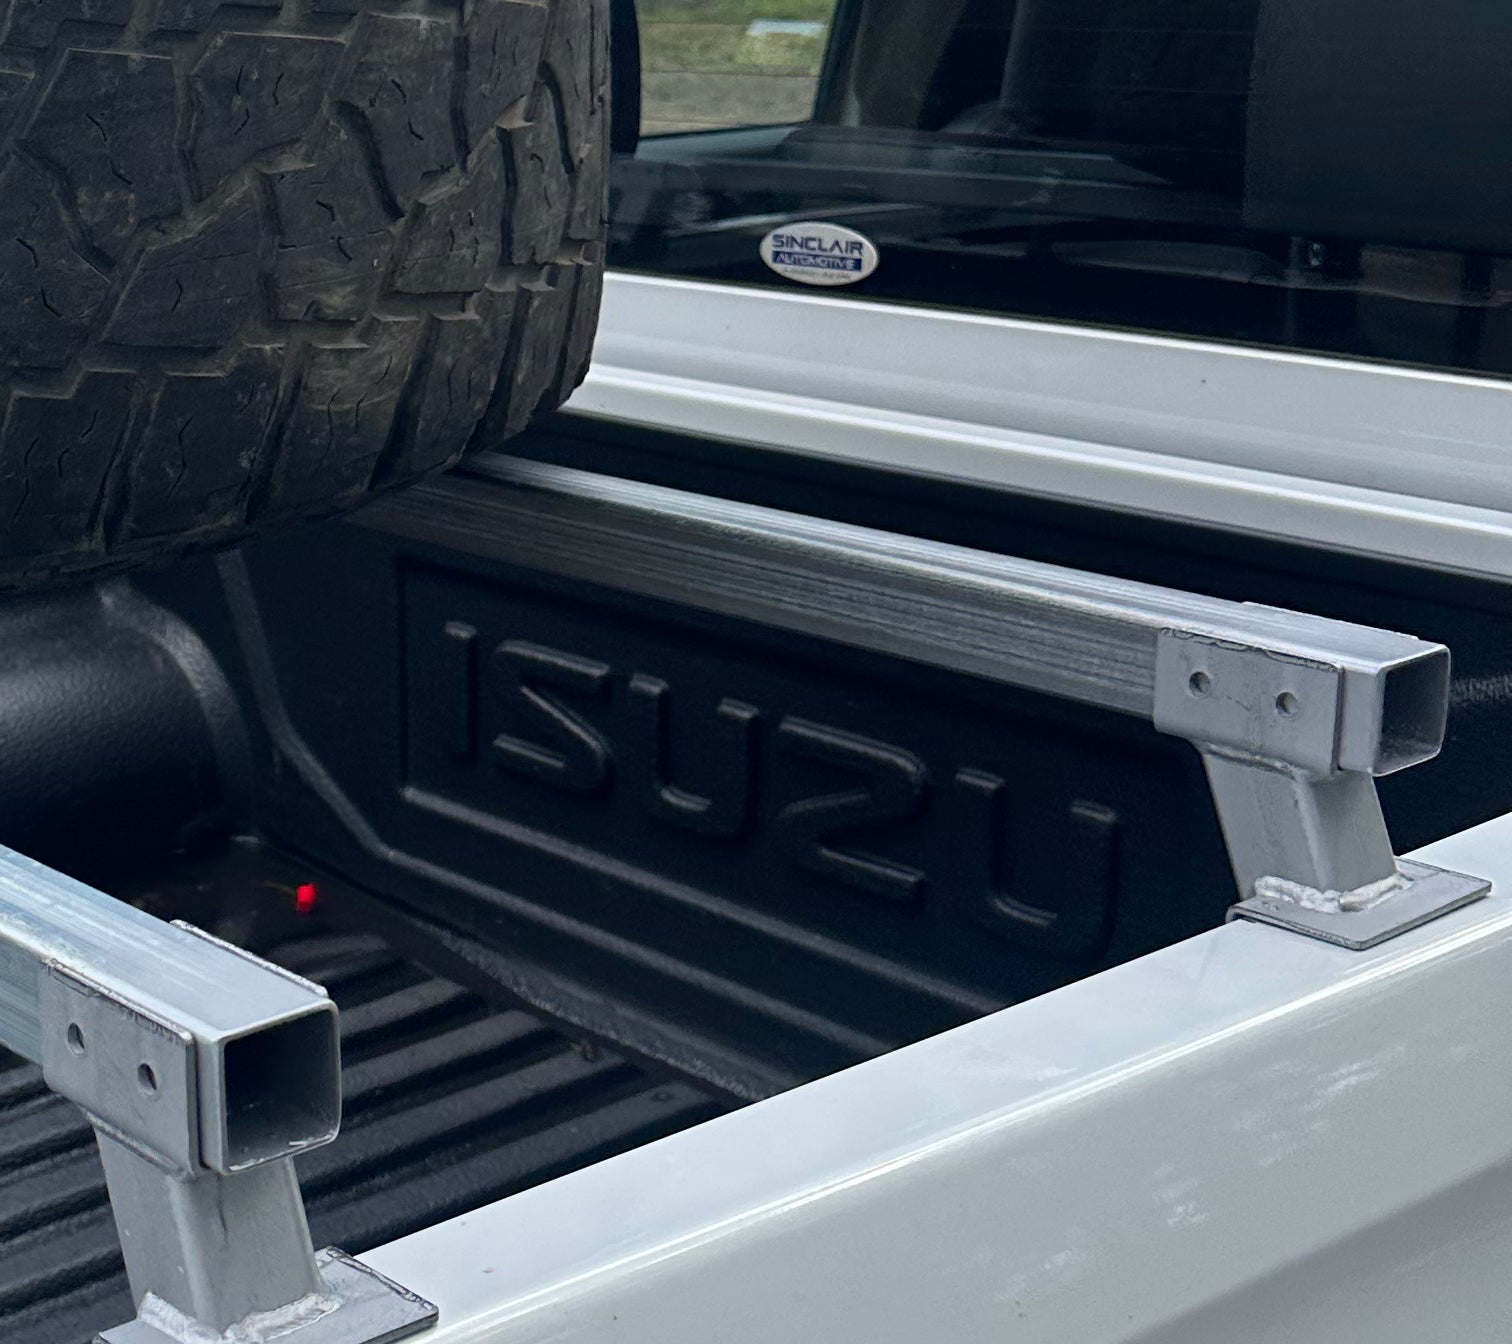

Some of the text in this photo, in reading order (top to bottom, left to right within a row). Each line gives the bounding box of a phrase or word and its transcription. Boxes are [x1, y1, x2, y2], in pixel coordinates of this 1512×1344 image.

[772, 234, 863, 256] SINCLAIR
[776, 253, 857, 270] AUTOMOTIVE
[443, 618, 1121, 962] ISUZU
